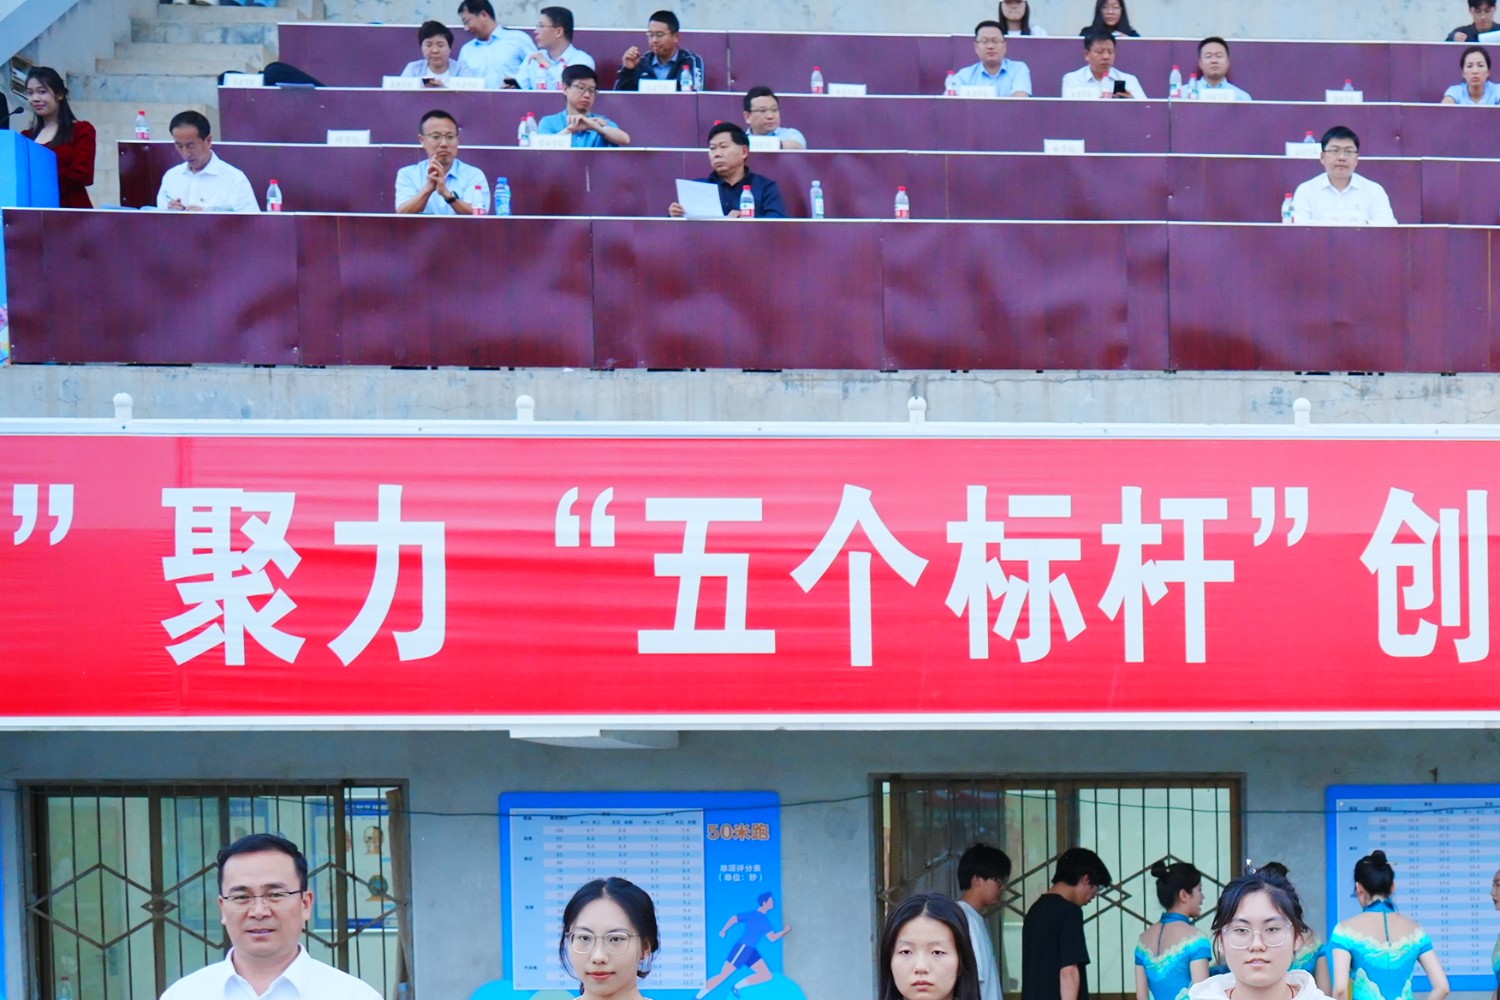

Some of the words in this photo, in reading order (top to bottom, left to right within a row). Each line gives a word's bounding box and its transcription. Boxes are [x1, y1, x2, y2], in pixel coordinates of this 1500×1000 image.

[707, 823, 770, 841] 50米跑
[720, 864, 761, 872] 单项评分表
